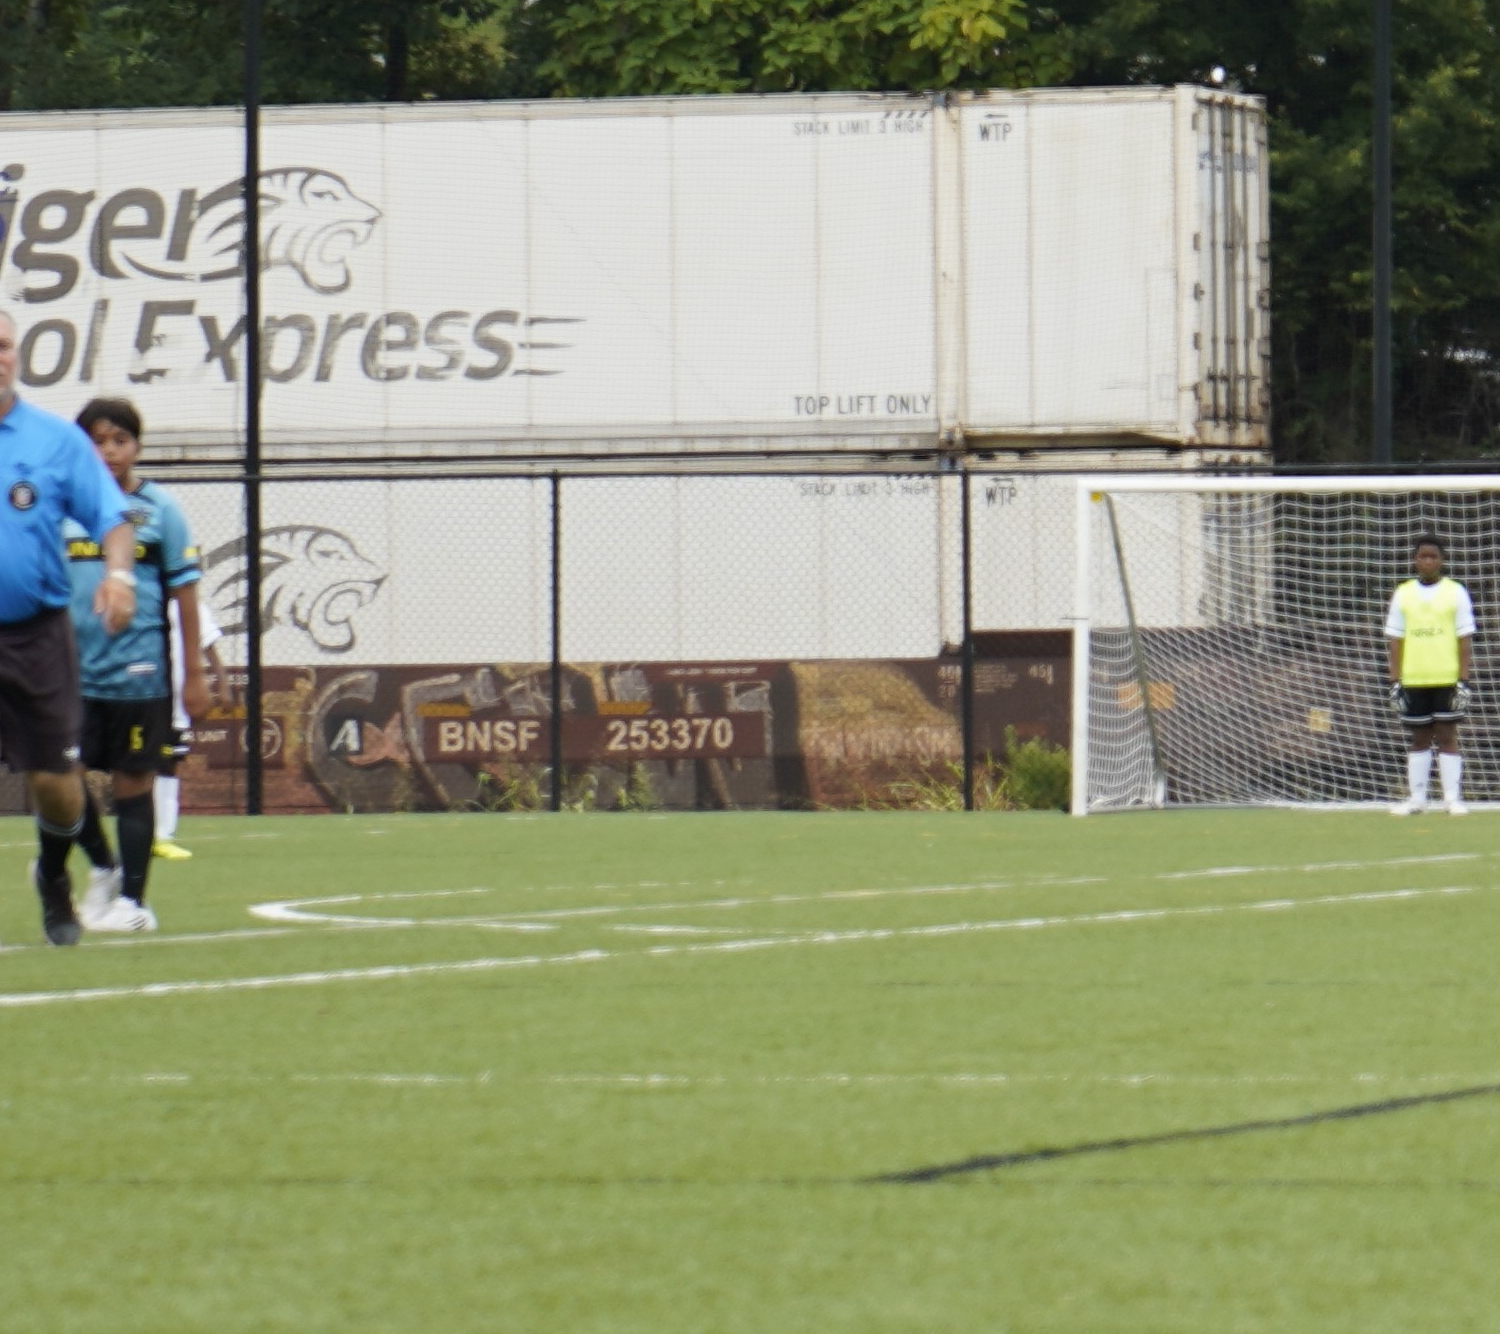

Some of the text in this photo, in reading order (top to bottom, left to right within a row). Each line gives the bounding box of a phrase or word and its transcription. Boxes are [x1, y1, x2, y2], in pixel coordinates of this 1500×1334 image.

[793, 121, 829, 135] STACK
[838, 120, 870, 135] LIMIT
[895, 119, 924, 133] HIGH
[979, 123, 1012, 141] WTP
[129, 298, 524, 385] Express
[794, 395, 932, 415] TOP LIFT ONLY
[985, 486, 1017, 505] WTP
[438, 717, 735, 753] BNSF 253370
